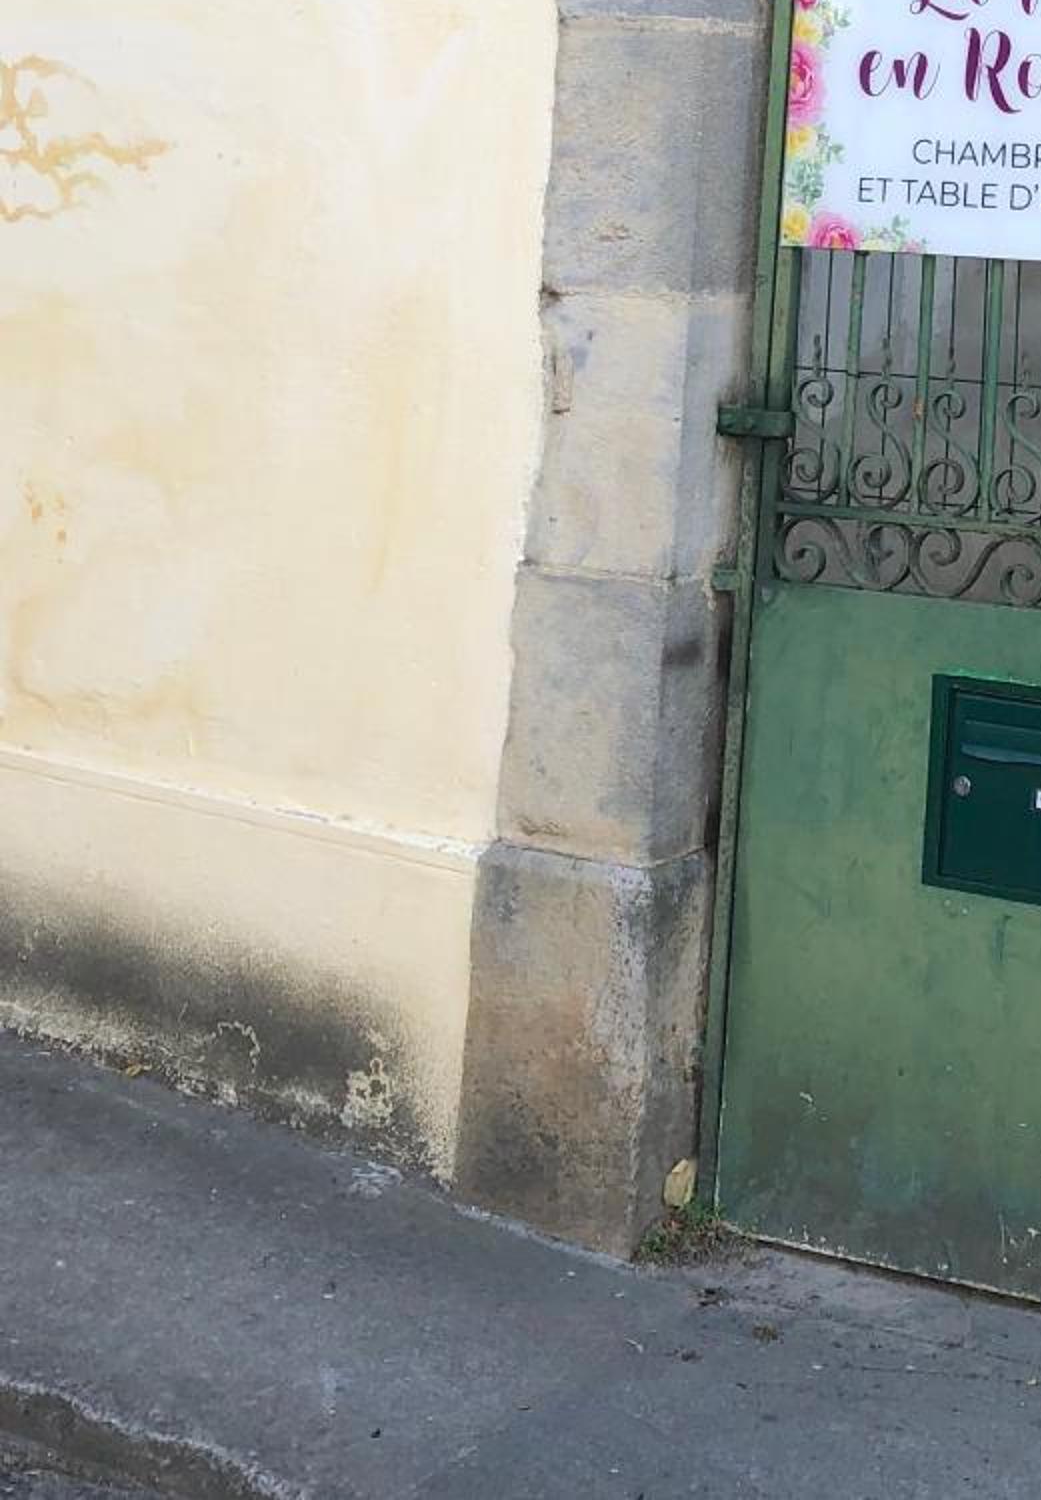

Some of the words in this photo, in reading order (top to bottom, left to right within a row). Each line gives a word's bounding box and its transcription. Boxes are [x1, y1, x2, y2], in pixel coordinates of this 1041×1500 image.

[858, 49, 941, 100] en
[857, 177, 894, 203] ET
[900, 178, 998, 210] TABLE
